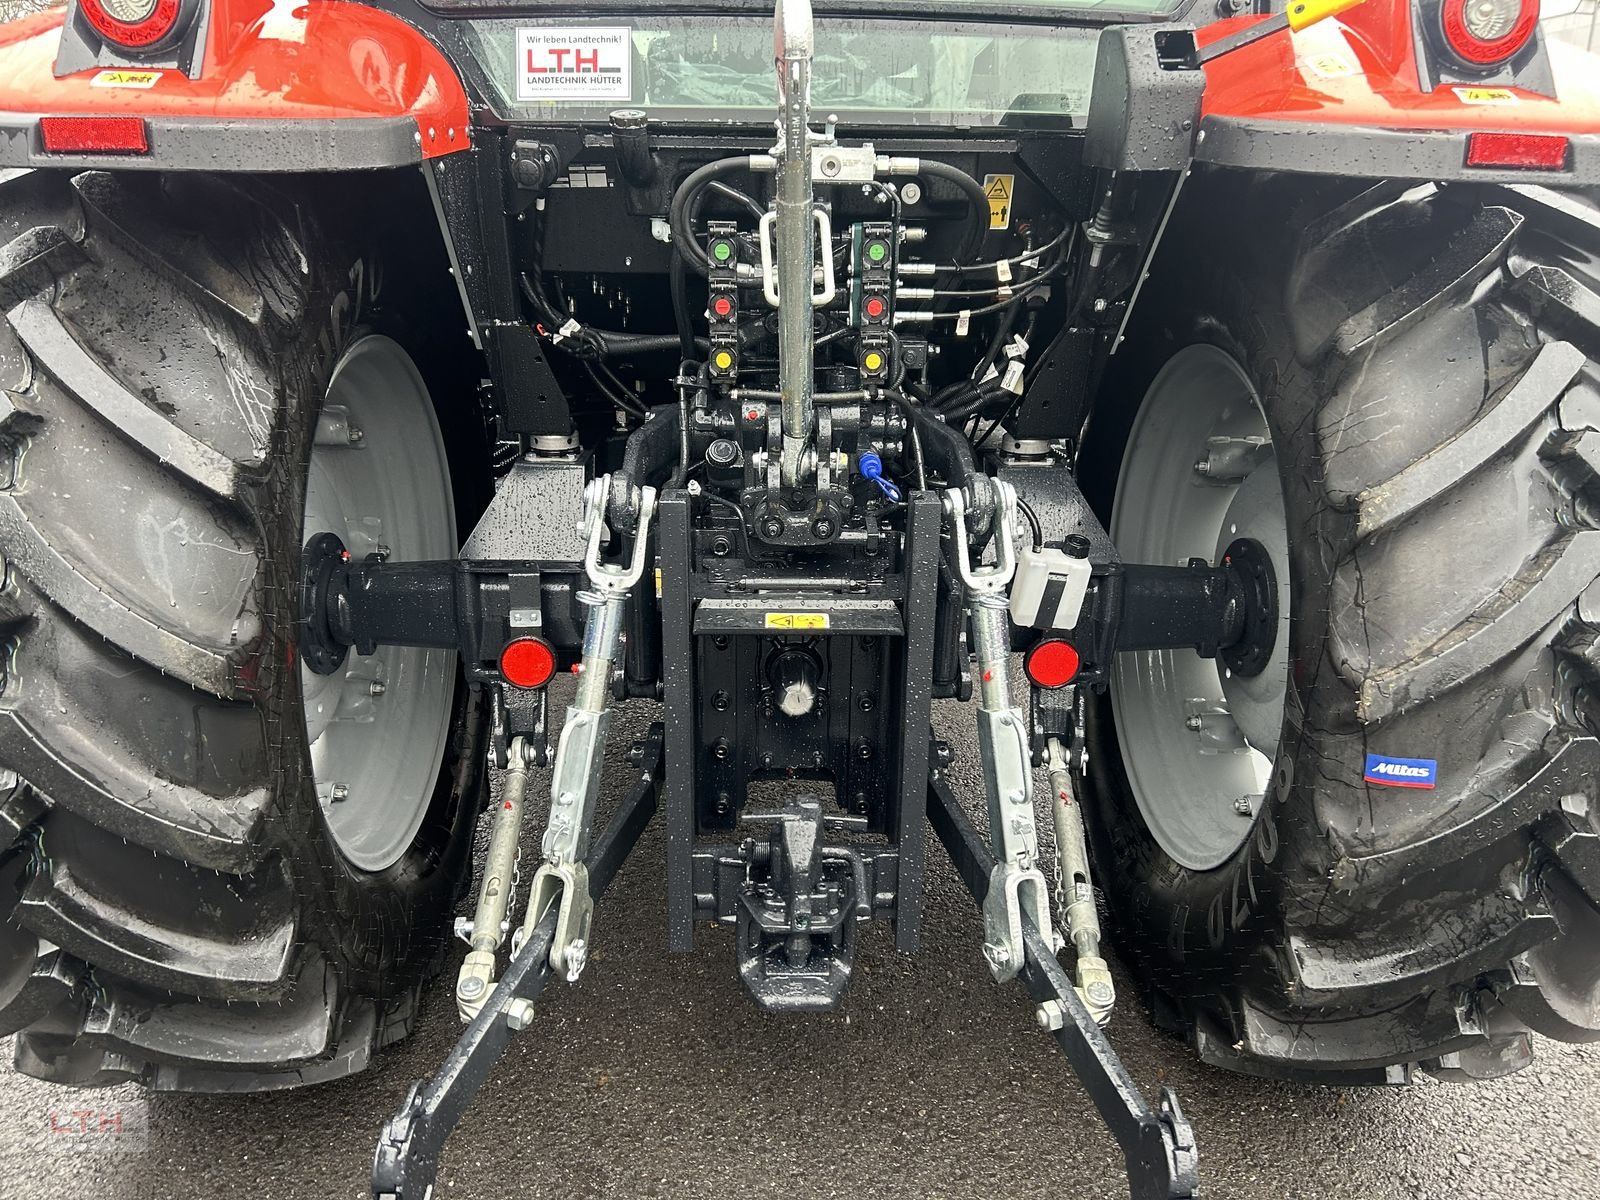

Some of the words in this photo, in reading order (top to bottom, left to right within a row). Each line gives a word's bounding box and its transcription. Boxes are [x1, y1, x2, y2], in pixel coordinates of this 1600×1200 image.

[526, 35, 541, 43] Wir
[543, 35, 566, 43] leben
[569, 35, 622, 43] Landtechnik!
[527, 76, 587, 84] LANDTECHNIK
[590, 75, 622, 84] HÜTTER
[1372, 762, 1430, 777] Mitas
